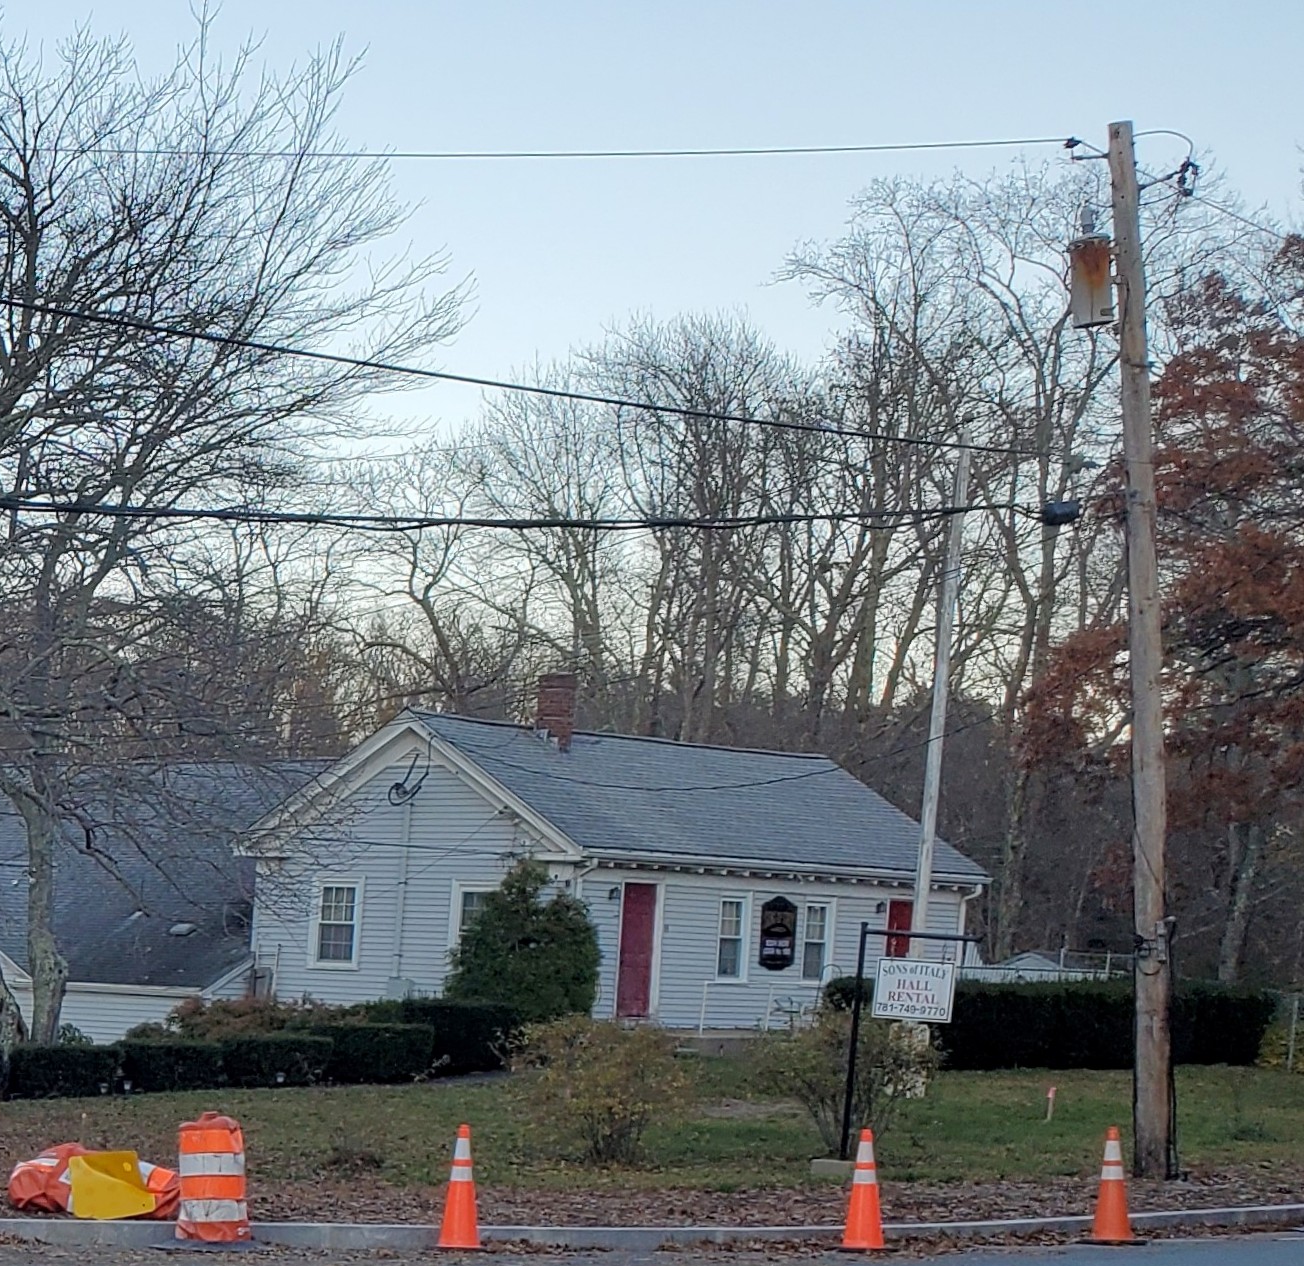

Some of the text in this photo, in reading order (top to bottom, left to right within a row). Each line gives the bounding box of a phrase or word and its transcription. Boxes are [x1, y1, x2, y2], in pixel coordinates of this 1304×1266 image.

[882, 964, 908, 976] SONS
[918, 964, 946, 980] ITALY
[896, 978, 932, 992] HALL
[887, 990, 939, 1005] RENTAL
[876, 1002, 946, 1017] 781-749-9770
